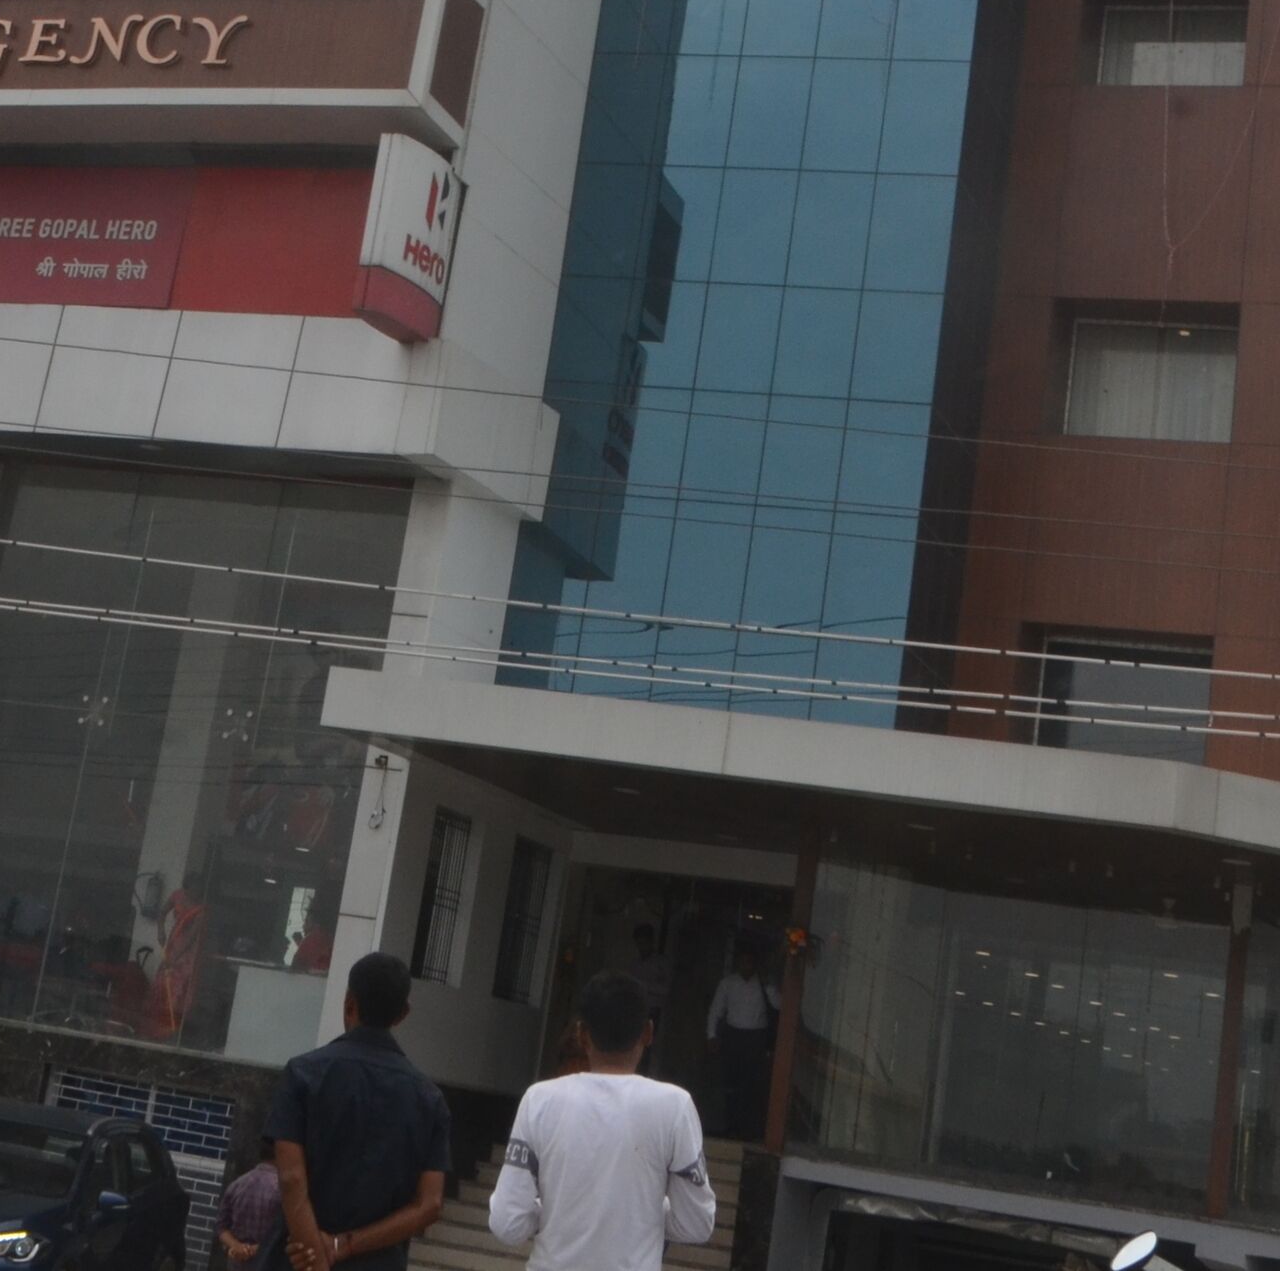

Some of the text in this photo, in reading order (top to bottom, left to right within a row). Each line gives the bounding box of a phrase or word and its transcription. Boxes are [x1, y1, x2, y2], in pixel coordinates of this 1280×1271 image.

[38, 218, 100, 239] GOPAL
[105, 220, 158, 240] HERO
[35, 256, 148, 280] श्री गोपाल हीरो
[402, 233, 446, 285] Hero
